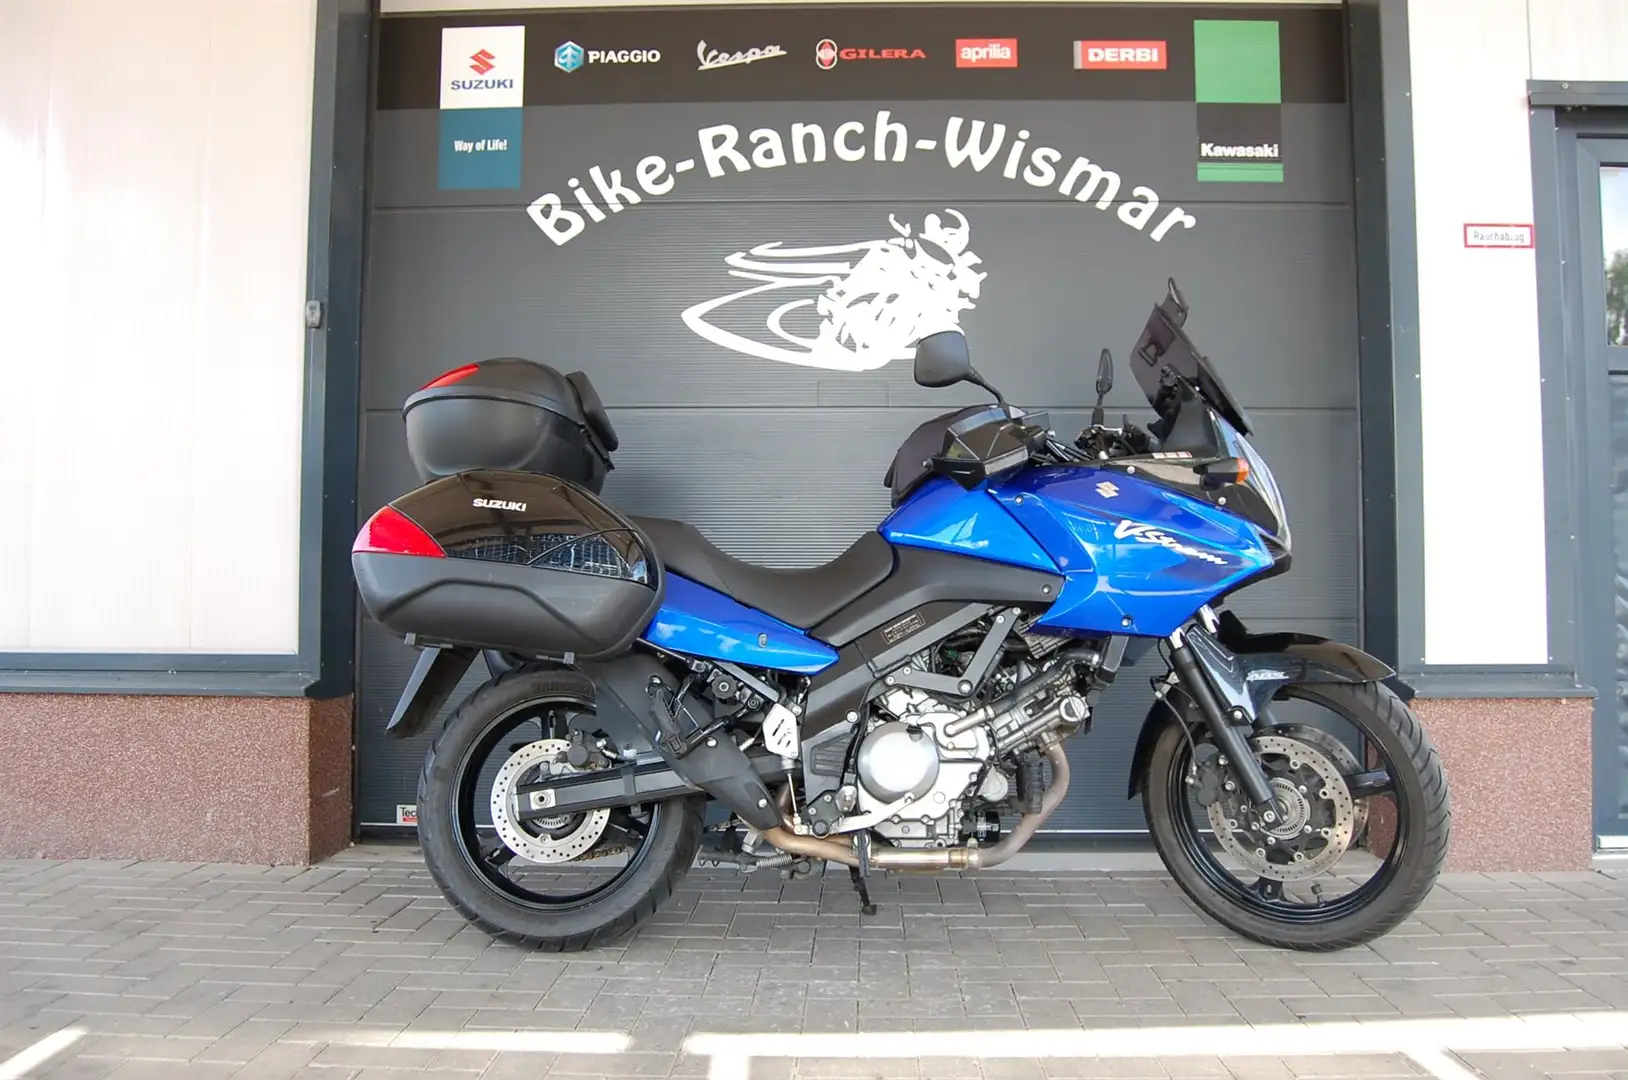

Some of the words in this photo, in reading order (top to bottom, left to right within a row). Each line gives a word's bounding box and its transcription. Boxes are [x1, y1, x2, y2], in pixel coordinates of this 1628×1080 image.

[588, 49, 661, 63] PIAGGIO
[697, 40, 787, 71] Vespa
[840, 48, 926, 60] GILERA
[961, 44, 1011, 62] aprilia
[1087, 48, 1159, 62] DERBI
[450, 79, 514, 90] SUZUKI
[454, 140, 474, 153] Way
[475, 139, 486, 151] of
[487, 139, 508, 151] Life!
[1201, 143, 1279, 157] Kawasaki
[526, 110, 1197, 247] Bike-Ranch-Wismar
[473, 498, 527, 512] SUZUKI
